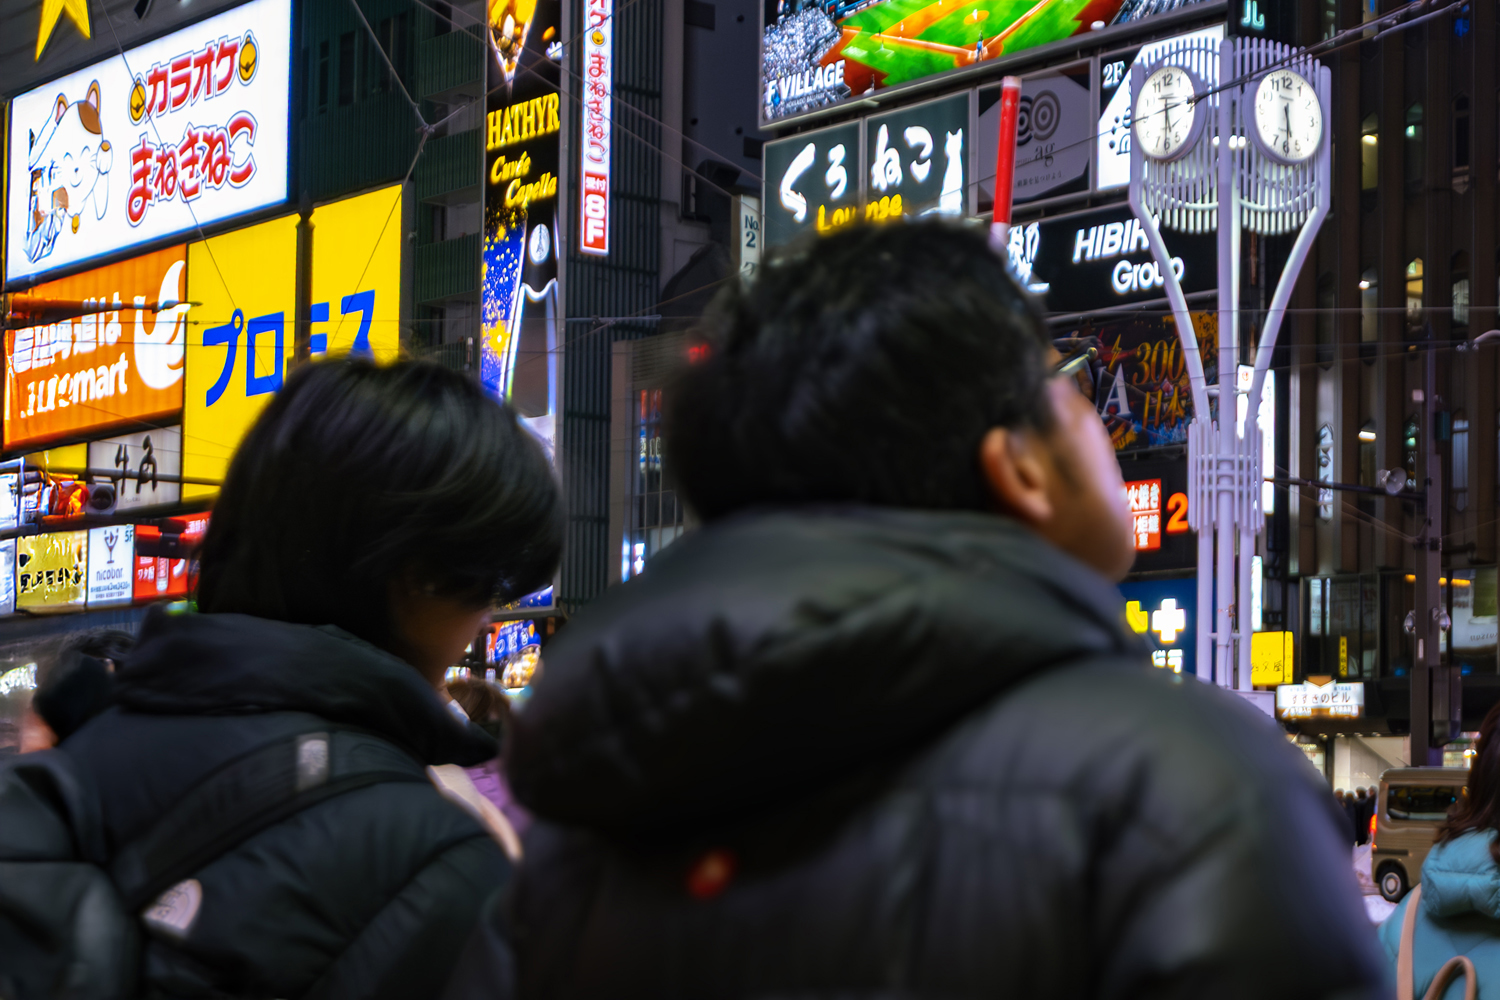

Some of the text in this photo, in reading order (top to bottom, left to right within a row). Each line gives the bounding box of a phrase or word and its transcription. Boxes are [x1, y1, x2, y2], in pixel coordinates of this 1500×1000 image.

[145, 33, 239, 117] カラオケ
[779, 60, 846, 100] VILLAGE
[1102, 60, 1125, 89] 2F
[1163, 73, 1173, 86] 12
[1281, 77, 1293, 90] 12
[486, 92, 561, 150] HATHYR
[587, 50, 610, 164] まねきねこ
[126, 111, 257, 227] まねきねこ
[491, 152, 531, 183] Cuvée
[585, 175, 607, 191] 受付
[780, 123, 933, 222] くろねこ
[505, 172, 557, 208] Capella
[586, 194, 606, 245] 8F
